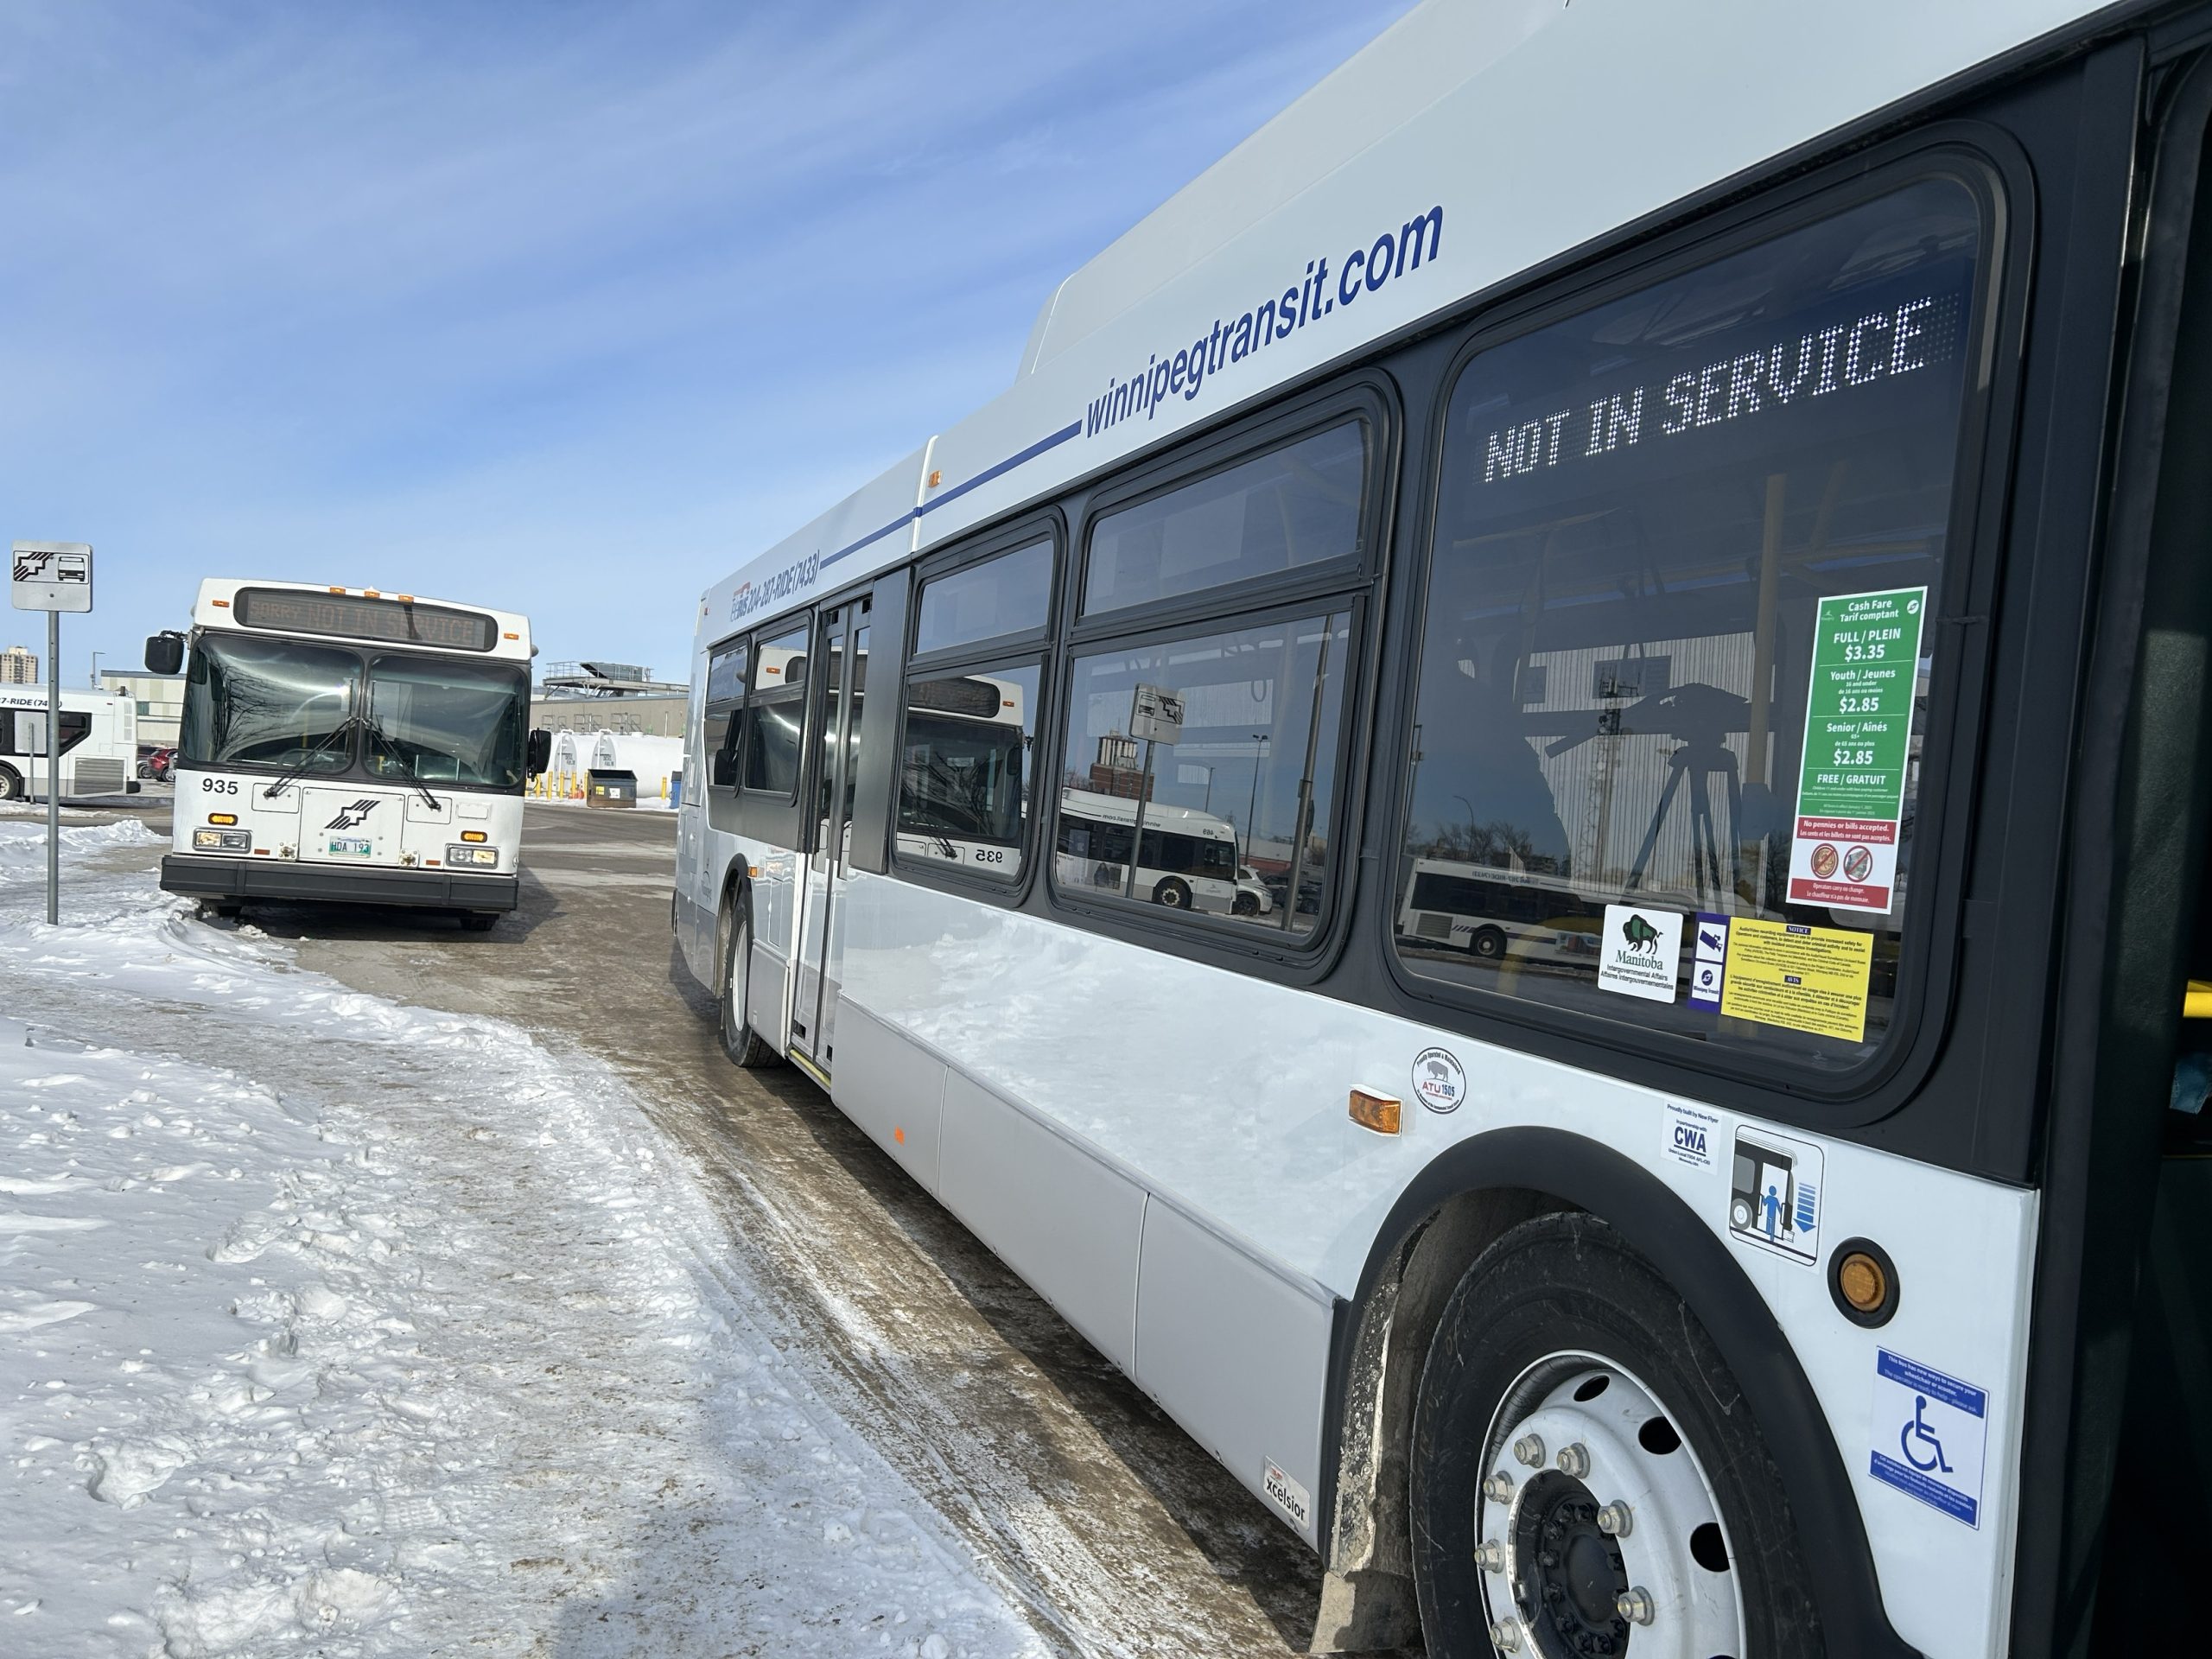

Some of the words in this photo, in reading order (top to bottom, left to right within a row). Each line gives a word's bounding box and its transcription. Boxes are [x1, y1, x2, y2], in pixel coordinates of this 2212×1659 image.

[1085, 205, 1444, 438] winnipegtransit.com
[1484, 409, 1570, 483] NOT
[1585, 385, 1643, 456] IN
[1662, 296, 1932, 435] SERVICE
[1849, 601, 1870, 612] Cash
[1872, 600, 1892, 608] Fare
[305, 603, 346, 631] NOT
[354, 608, 378, 633] IN
[1840, 613, 1858, 622] Tarif
[1859, 609, 1899, 620] comptant
[1834, 632, 1859, 643] FULL
[1868, 628, 1901, 641] PLEIN
[1844, 645, 1885, 662] $3.35
[1830, 670, 1855, 681] Youth
[1863, 669, 1896, 679] Jeunes
[34, 700, 62, 709] (74)
[1839, 696, 1878, 714] $2.85
[1827, 722, 1855, 732] Senior
[1862, 721, 1887, 731] Aînés
[1834, 748, 1873, 766] $2.85
[202, 778, 238, 795] 935
[1816, 774, 1839, 784] FREE
[1846, 774, 1885, 785] GRATUIT
[1859, 823, 1889, 832] accepted.
[331, 842, 347, 851] HDA
[354, 843, 370, 852] 193
[1615, 950, 1663, 969] Manitoba
[1600, 970, 1618, 979] Affaires
[1607, 964, 1650, 978] Intergovernmental
[1651, 972, 1668, 982] Affairs
[1422, 1082, 1440, 1094] ATU
[1442, 1084, 1455, 1097] 1505
[1668, 1104, 1682, 1113] Proudly
[1675, 1127, 1707, 1153] CWA
[1267, 1478, 1305, 1521] xcelsior
